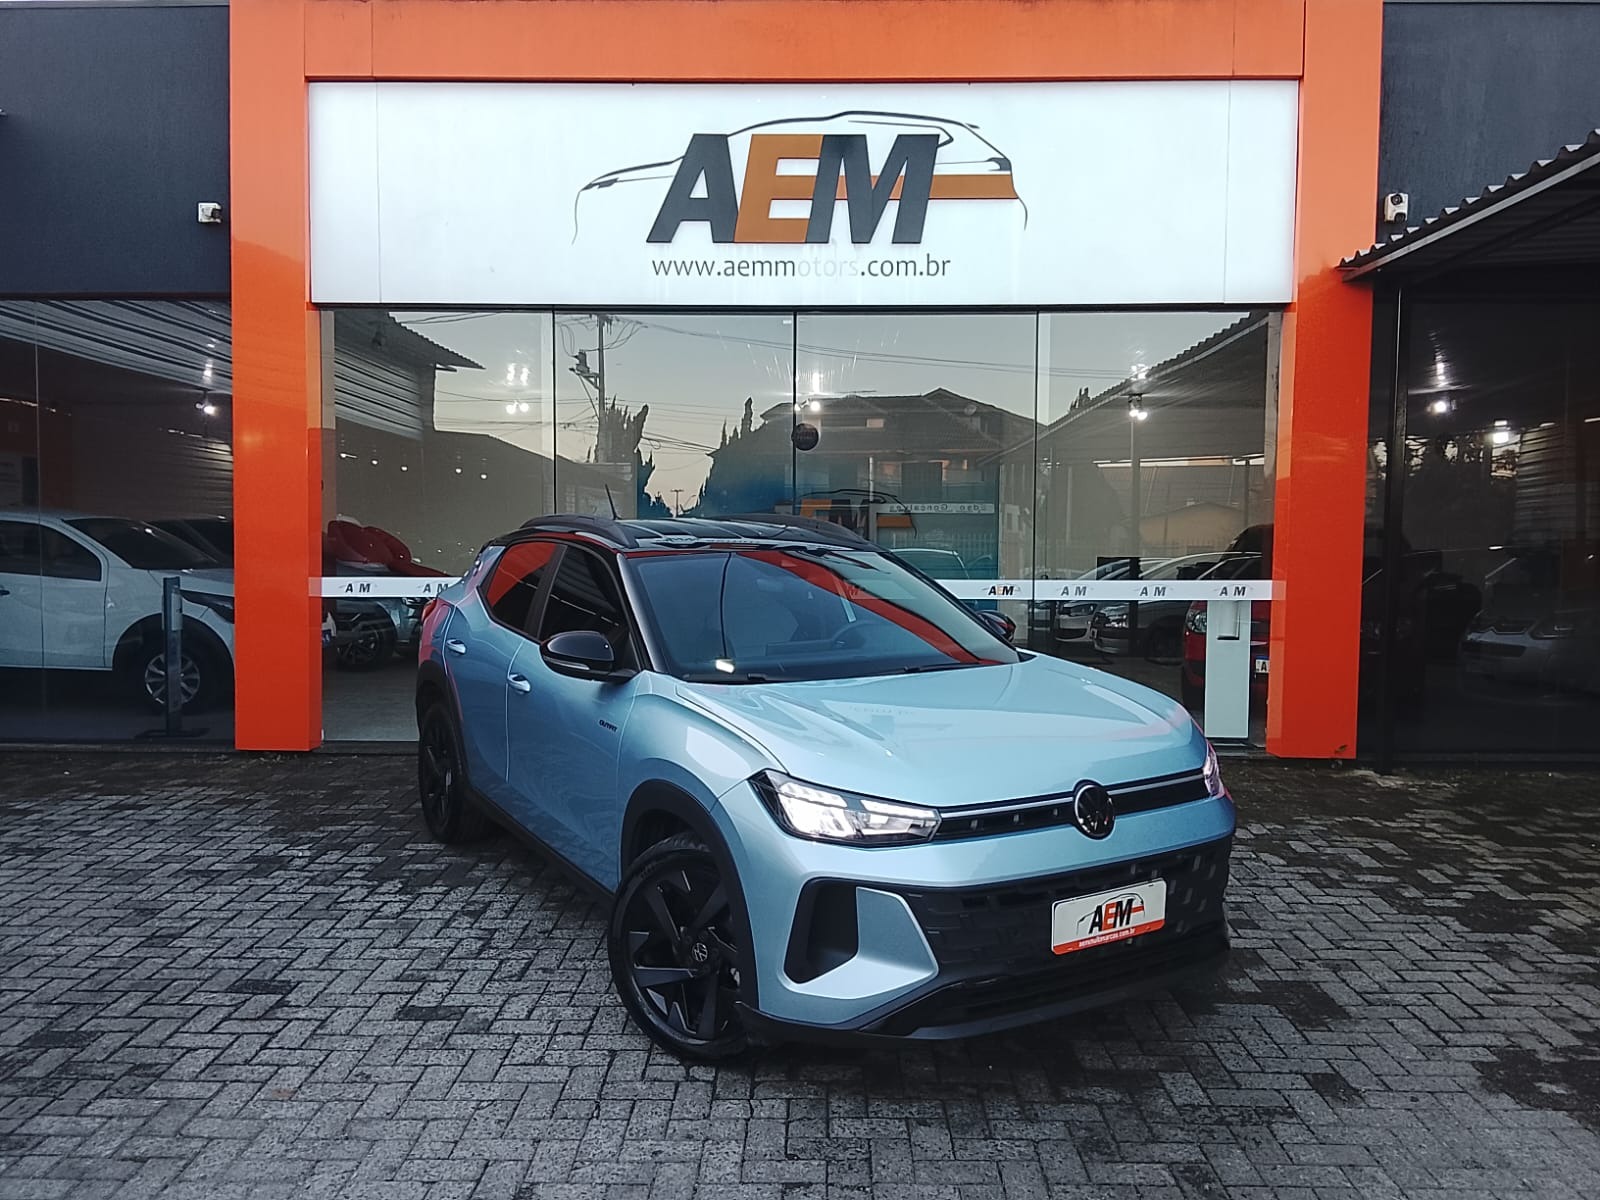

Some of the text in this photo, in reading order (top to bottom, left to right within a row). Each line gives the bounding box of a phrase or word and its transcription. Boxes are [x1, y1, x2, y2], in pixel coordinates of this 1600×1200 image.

[646, 133, 940, 244] AEM
[652, 253, 951, 277] www.aemmotors.com.br
[1088, 898, 1135, 934] AEM
